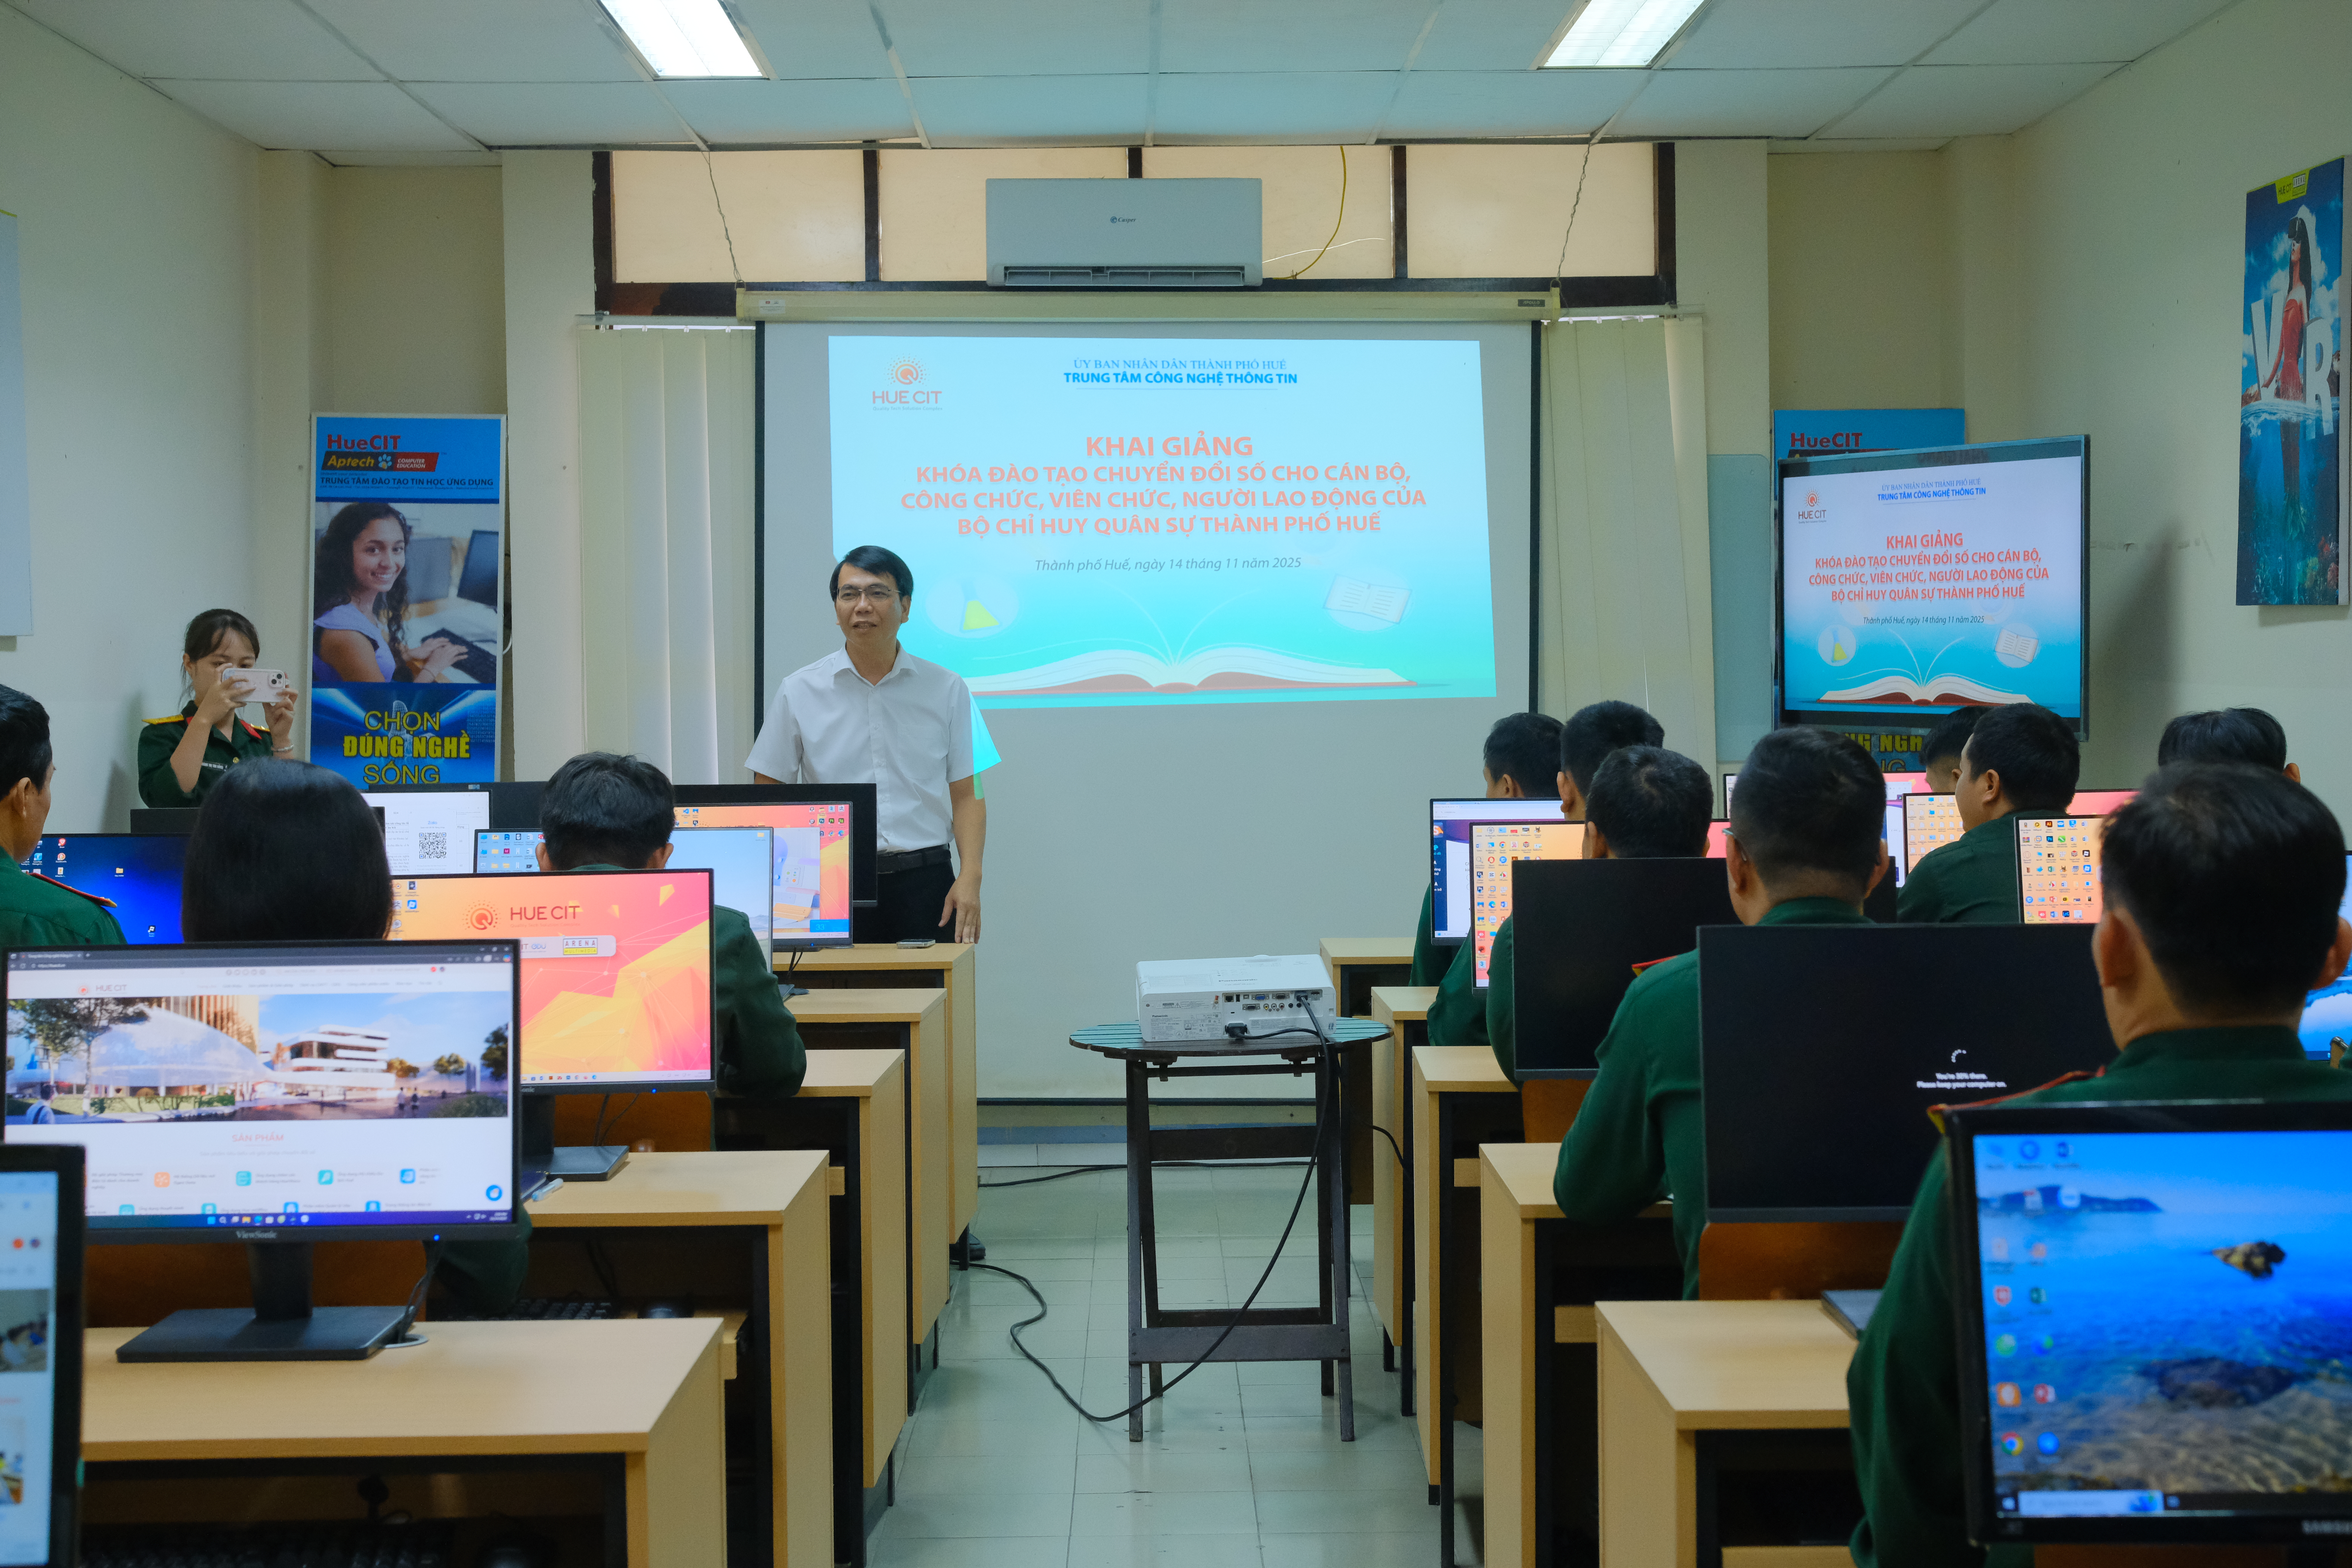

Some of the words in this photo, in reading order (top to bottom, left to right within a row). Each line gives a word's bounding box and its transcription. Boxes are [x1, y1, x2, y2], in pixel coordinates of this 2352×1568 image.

[1073, 357, 1091, 369] ỦY
[1094, 360, 1119, 369] BAN
[1123, 358, 1158, 369] NHÂN
[1162, 359, 1188, 369] DÂN
[1190, 358, 1232, 369] THÀNH
[1235, 358, 1259, 369] PHỐ
[1263, 358, 1287, 370] HUẾ
[1064, 372, 1110, 383] TRUNG
[1113, 371, 1141, 383] TÂM
[1145, 371, 1183, 383] CÔNG
[1187, 372, 1223, 386] NGHỆ
[1226, 372, 1273, 384] THÔNG
[1276, 373, 1297, 384] TIN
[872, 390, 910, 404] HUE
[913, 390, 942, 404] CIT
[327, 434, 401, 450] HueCIT
[1087, 437, 1154, 456] KHAI
[1162, 430, 1253, 456] GIẢNG
[1790, 432, 1863, 449] HueCIT
[327, 455, 375, 468] Aptech
[351, 476, 369, 485] TÂM
[447, 477, 466, 486] ỨNG
[917, 464, 983, 482] KHÓA
[988, 463, 1039, 482] ĐÀO
[1043, 466, 1088, 486] TẠO
[1094, 461, 1184, 482] CHUYỂN
[1190, 461, 1230, 482] ĐỔI
[1237, 461, 1266, 481] SỐ
[1272, 466, 1319, 481] CHO
[1325, 462, 1369, 481] CÁN
[1376, 462, 1411, 485] BỘ,
[1904, 482, 1920, 490] NHÂN
[1921, 481, 1933, 489] DÂN
[1934, 480, 1955, 488] THÀNH
[901, 490, 967, 509] CÔNG
[973, 488, 1044, 510] CHỨC,
[1049, 489, 1101, 508] VIÊN
[1107, 488, 1176, 509] CHỨC,
[1183, 488, 1256, 507] NGƯỜI
[1263, 490, 1306, 507] LAO
[1311, 487, 1377, 510] ĐỘNG
[1382, 485, 1427, 505] CỦA
[1899, 492, 1913, 500] TÂM
[1914, 490, 1931, 499] CÔNG
[1932, 489, 1950, 499] NGHỆ
[1952, 488, 1974, 496] THÔNG
[1798, 510, 1814, 520] HUE
[1815, 510, 1827, 519] CIT
[958, 516, 990, 539] BỘ
[996, 513, 1034, 534] CHỈ
[1041, 518, 1089, 534] HUY
[1094, 514, 1159, 535] QUÂN
[1166, 515, 1196, 537] SỰ
[1200, 514, 1278, 533] THÀNH
[1285, 511, 1331, 532] PHỐ
[1337, 511, 1381, 531] HUẾ
[1886, 534, 1917, 549] KHAI
[1920, 529, 1963, 547] GIẢNG
[1035, 559, 1075, 571] Thành
[1077, 559, 1102, 573] phố
[1105, 558, 1130, 572] Huế,
[1134, 559, 1165, 572] ngày
[1169, 558, 1183, 569] 14
[1186, 557, 1222, 571] tháng
[1227, 558, 1238, 569] 11
[1242, 558, 1269, 568] năm
[1272, 557, 1302, 568] 2025
[1816, 556, 1842, 568] KHÓA
[1844, 554, 1866, 568] ĐÀO
[1868, 555, 1887, 570] TẠO
[1890, 551, 1931, 566] CHUYỂN
[1933, 550, 1952, 565] ĐỔI
[1955, 549, 1969, 564] SỐ
[1971, 551, 1995, 563] CHO
[1997, 549, 2020, 562] CÁN
[2023, 548, 2041, 564] BỘ,
[1809, 573, 1836, 585] CÔNG
[1838, 571, 1868, 585] CHỨC,
[1870, 570, 1893, 583] VIÊN
[1895, 570, 1926, 583] CHỨC,
[1929, 568, 1964, 582] NGƯỜI
[1966, 569, 1988, 581] LAO
[1990, 567, 2023, 583] ĐỘNG
[2026, 565, 2049, 579] CỦA
[1832, 588, 1845, 604] BỘ
[1847, 587, 1864, 601] CHỈ
[1866, 590, 1887, 600] HUY
[1889, 587, 1919, 601] QUÂN
[1921, 587, 1935, 602] SỰ
[1937, 586, 1974, 599] THÀNH
[1977, 583, 2000, 598] PHỐ
[2002, 583, 2025, 598] HUẾ
[1881, 616, 1892, 626] phố
[1893, 616, 1905, 625] Huế,
[1906, 617, 1920, 625] ngày
[1929, 616, 1946, 625] tháng
[364, 710, 440, 734] CHỌN
[343, 732, 403, 757] ĐÚNG
[413, 730, 471, 758] NGHỀ
[510, 906, 547, 920] HUE
[551, 906, 580, 920] CIT
